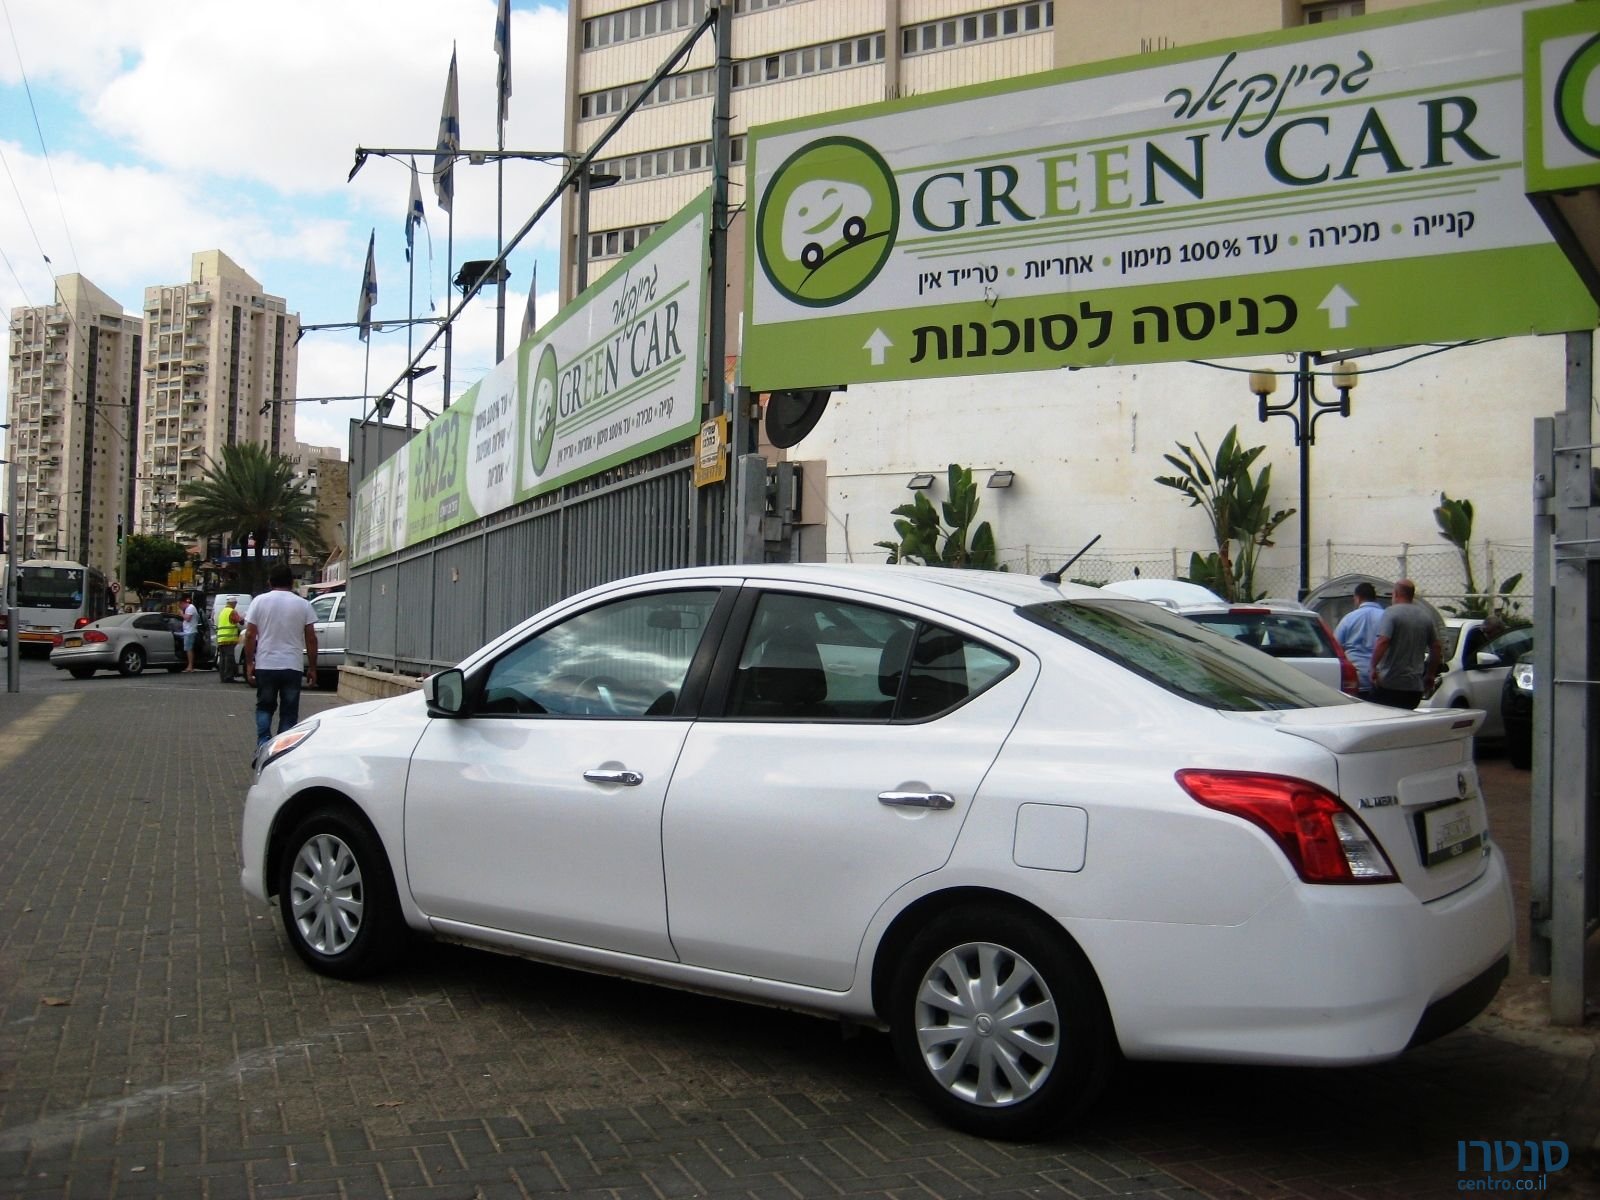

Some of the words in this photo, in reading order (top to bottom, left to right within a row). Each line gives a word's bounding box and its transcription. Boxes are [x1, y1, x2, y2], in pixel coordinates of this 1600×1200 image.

[912, 133, 1210, 232] GREEN
[1264, 95, 1501, 186] CAR
[1308, 221, 1380, 248] מכירה
[1413, 210, 1475, 238] קנייה
[1179, 238, 1241, 263] 100%
[1246, 233, 1279, 255] עד
[1023, 254, 1094, 280] אחריות
[1121, 244, 1172, 275] מימון
[918, 270, 942, 295] אין
[947, 264, 999, 287] טרייד
[909, 301, 1113, 364] לסוכנות
[1131, 293, 1299, 346] כניסה
[559, 336, 622, 418] GREEN
[630, 300, 682, 378] CAR
